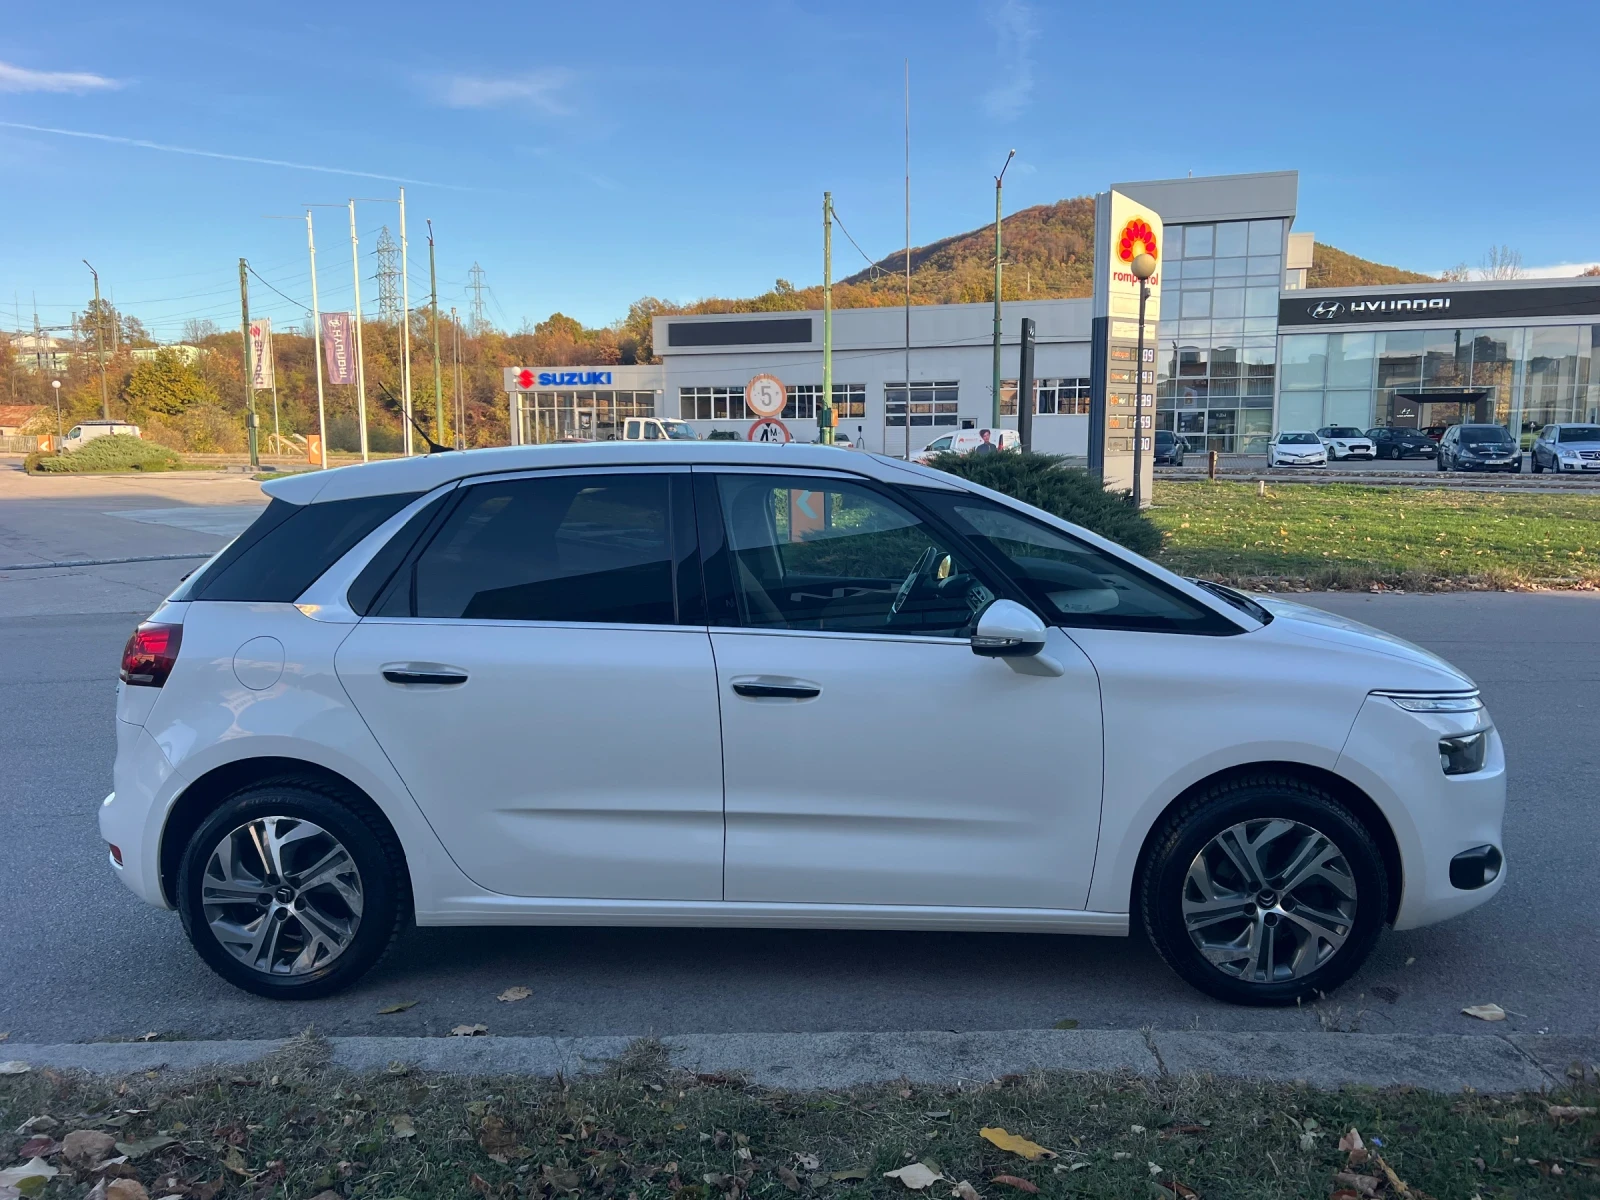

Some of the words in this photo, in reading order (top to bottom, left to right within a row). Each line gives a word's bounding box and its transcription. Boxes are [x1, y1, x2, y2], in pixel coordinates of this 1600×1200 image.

[1113, 271, 1159, 286] romprol
[1351, 299, 1450, 314] HYUNDAI
[538, 372, 612, 385] SUZUKI
[761, 386, 772, 406] 5
